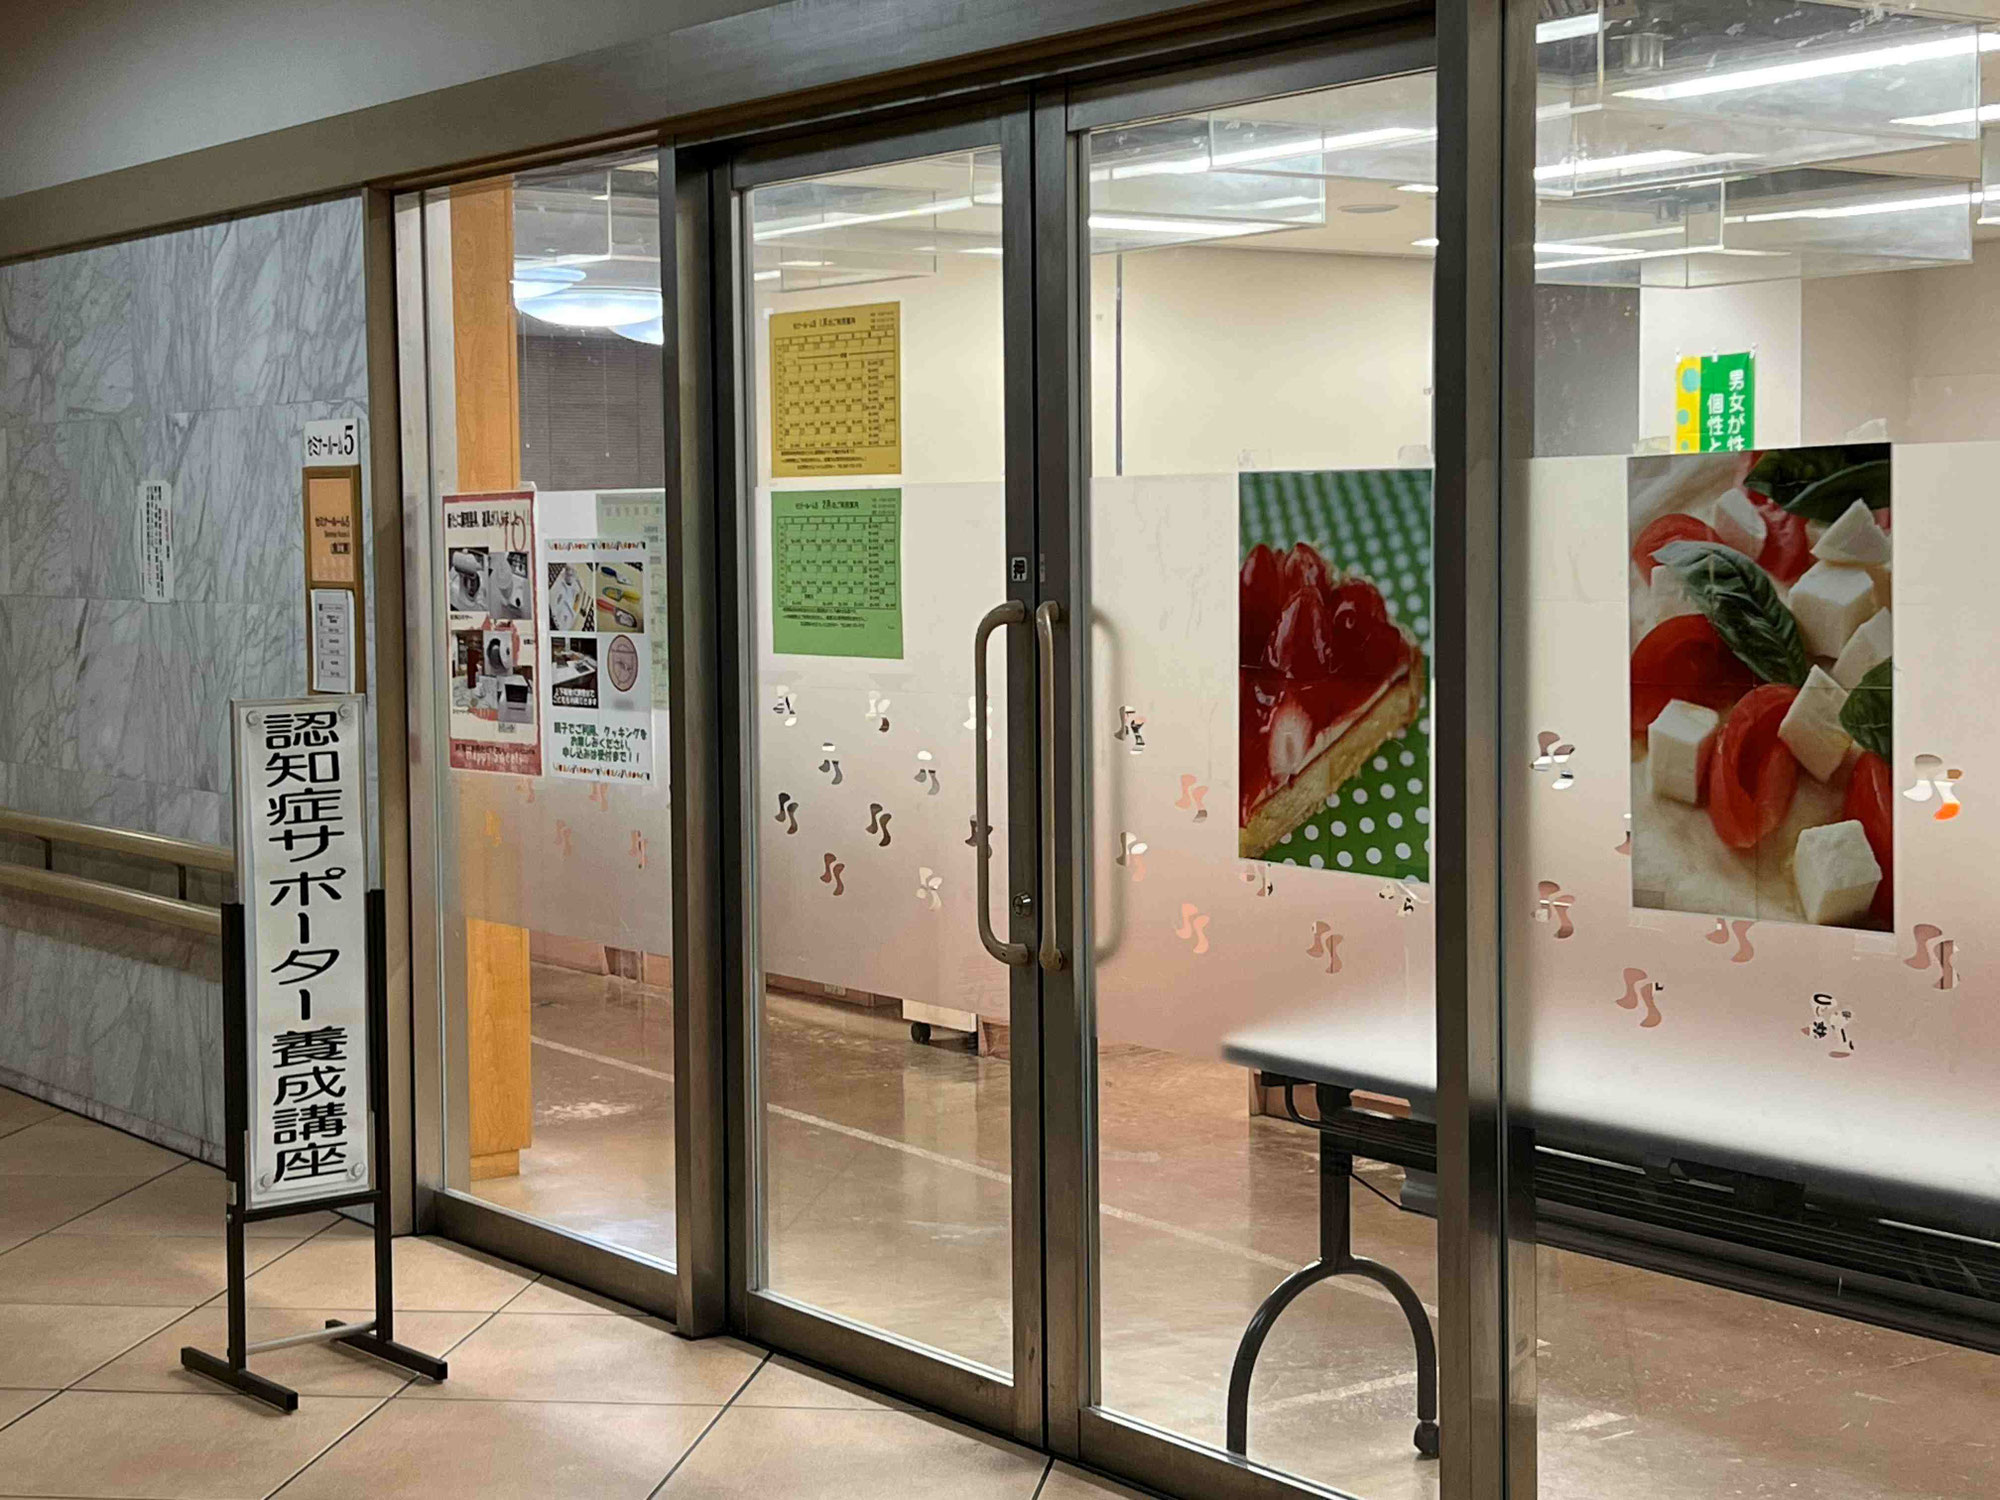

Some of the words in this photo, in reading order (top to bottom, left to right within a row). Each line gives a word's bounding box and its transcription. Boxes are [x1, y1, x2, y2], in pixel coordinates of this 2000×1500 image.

[1707, 393, 1724, 452] 個性と
[1727, 368, 1746, 452] 男女が性
[263, 710, 348, 1184] 認知症サポーター養成講座
